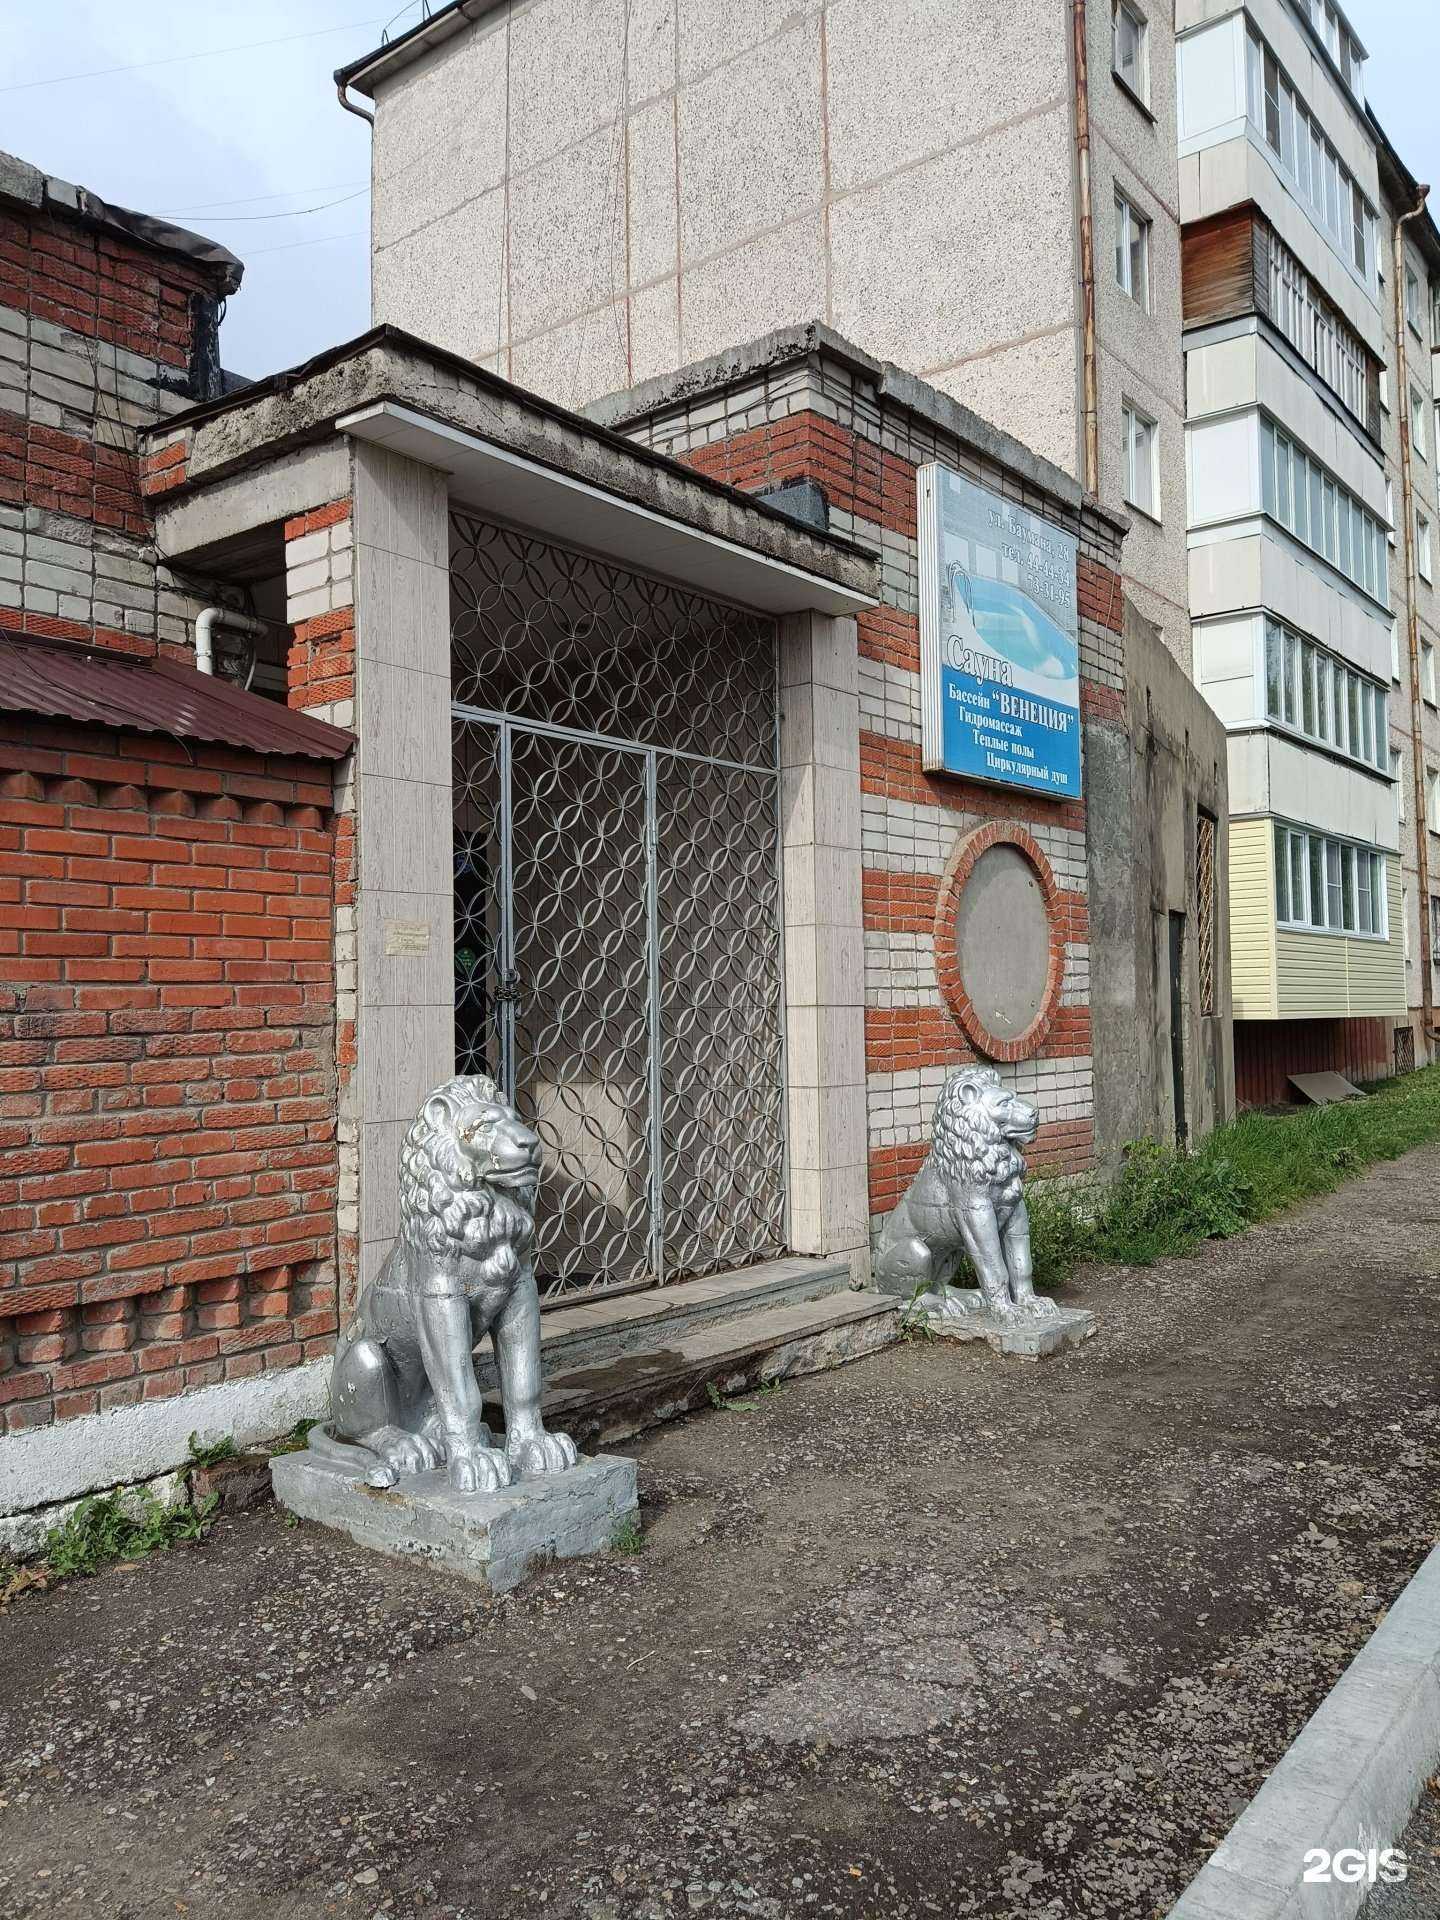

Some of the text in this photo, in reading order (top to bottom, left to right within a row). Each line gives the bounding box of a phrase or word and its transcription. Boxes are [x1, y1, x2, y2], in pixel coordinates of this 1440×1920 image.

[1009, 516, 1055, 558] Баумана,
[1058, 543, 1069, 562] 28
[947, 634, 1013, 688] Сауна
[948, 683, 990, 709] Бассейн
[959, 706, 1023, 737] Гидромассаж
[973, 729, 1035, 759] Теплые полы
[987, 752, 1068, 785] Циркулярный душ
